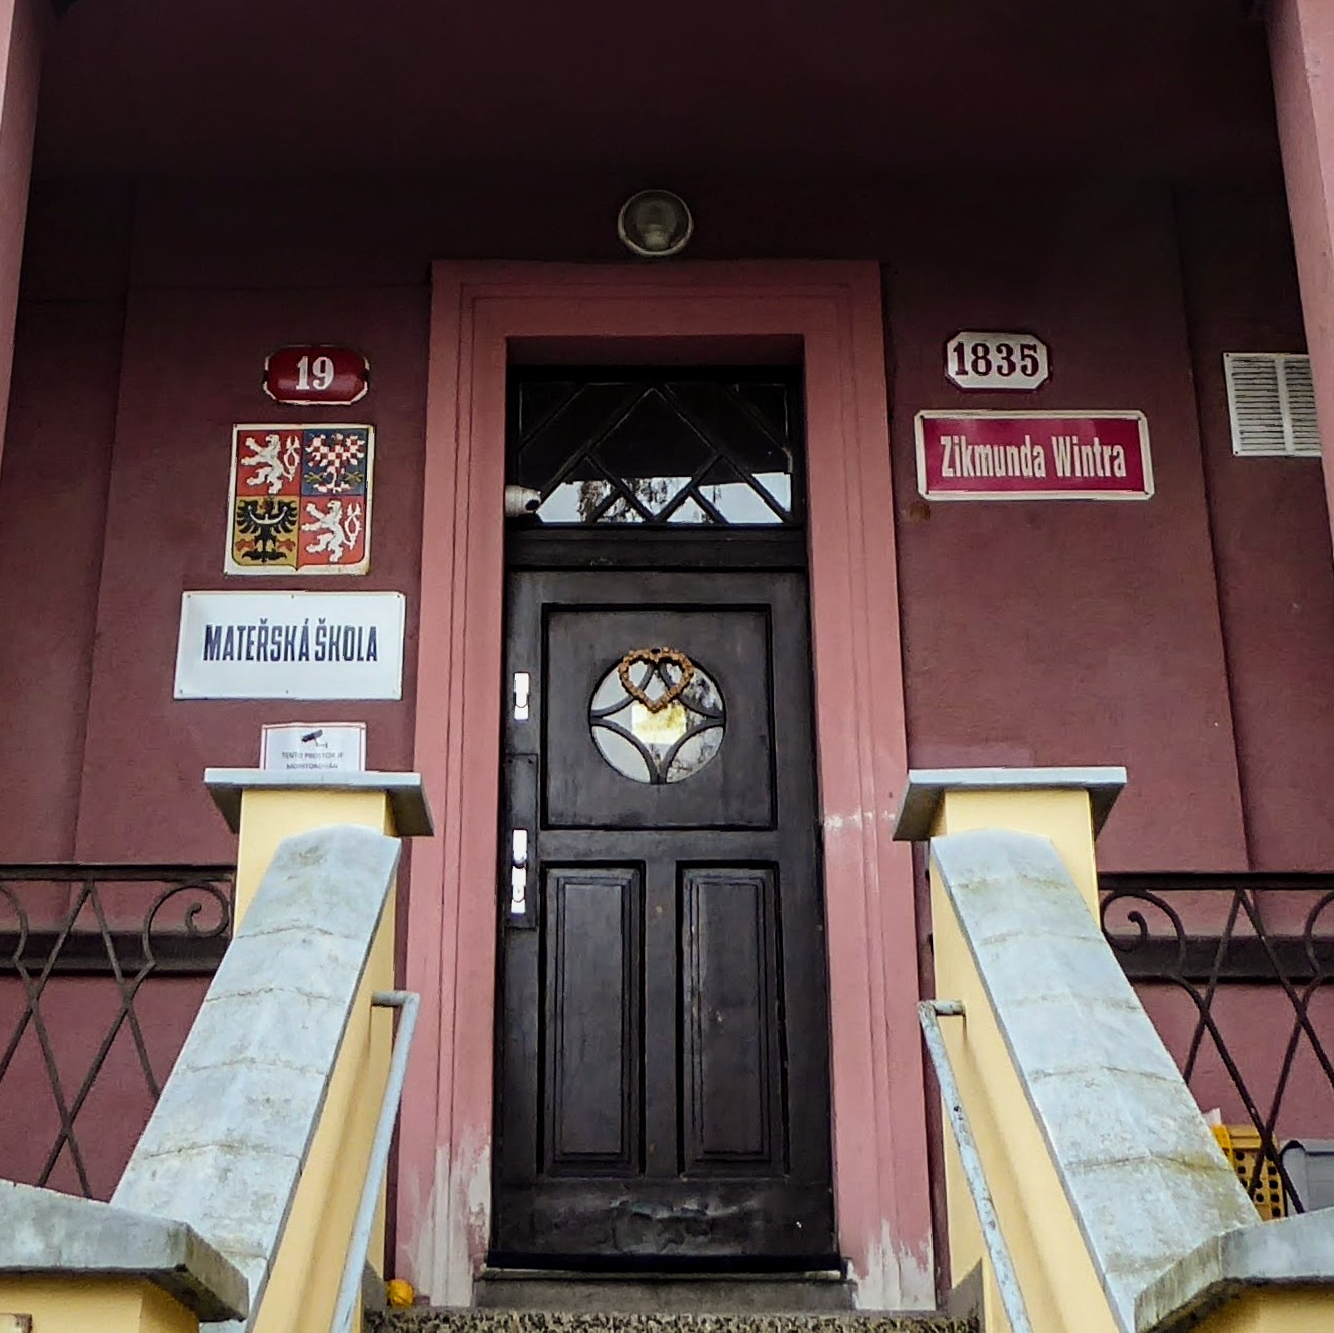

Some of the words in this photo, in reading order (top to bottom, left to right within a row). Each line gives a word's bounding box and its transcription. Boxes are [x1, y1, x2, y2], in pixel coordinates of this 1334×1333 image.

[296, 356, 334, 390] 19
[953, 341, 1040, 378] 1835
[940, 435, 1046, 478] Zikmunda
[1051, 435, 1126, 478] Wintra
[203, 618, 310, 662] MATEŘSKÁ
[314, 618, 378, 662] ŠKOLA
